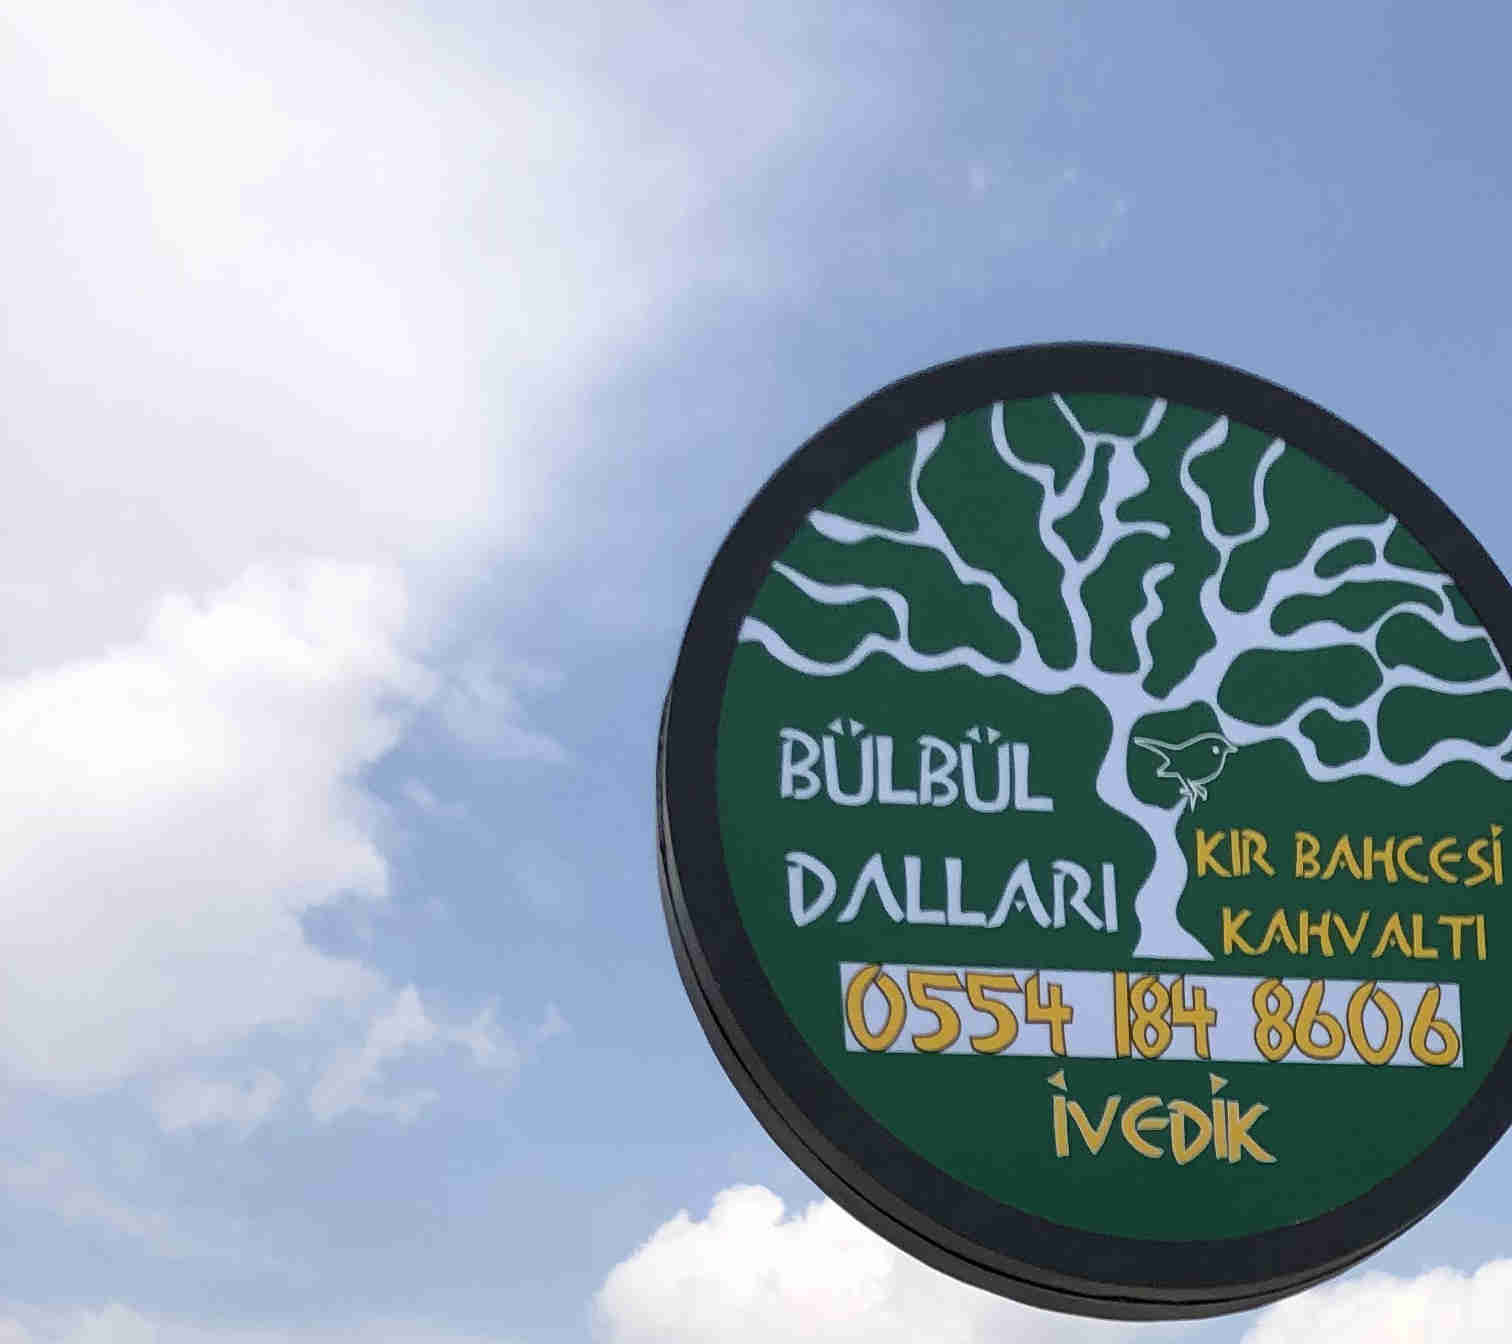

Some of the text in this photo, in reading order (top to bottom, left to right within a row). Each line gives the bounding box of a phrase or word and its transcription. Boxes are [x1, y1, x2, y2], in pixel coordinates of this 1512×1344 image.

[780, 718, 1054, 813] BÜLBÜL
[785, 851, 1119, 933] DALLARI
[1195, 828, 1276, 878] KIR
[1222, 906, 1487, 960] KAHVALTI
[846, 964, 1460, 1066] 0554 184 8606
[1047, 1071, 1278, 1166] İVEDİK
